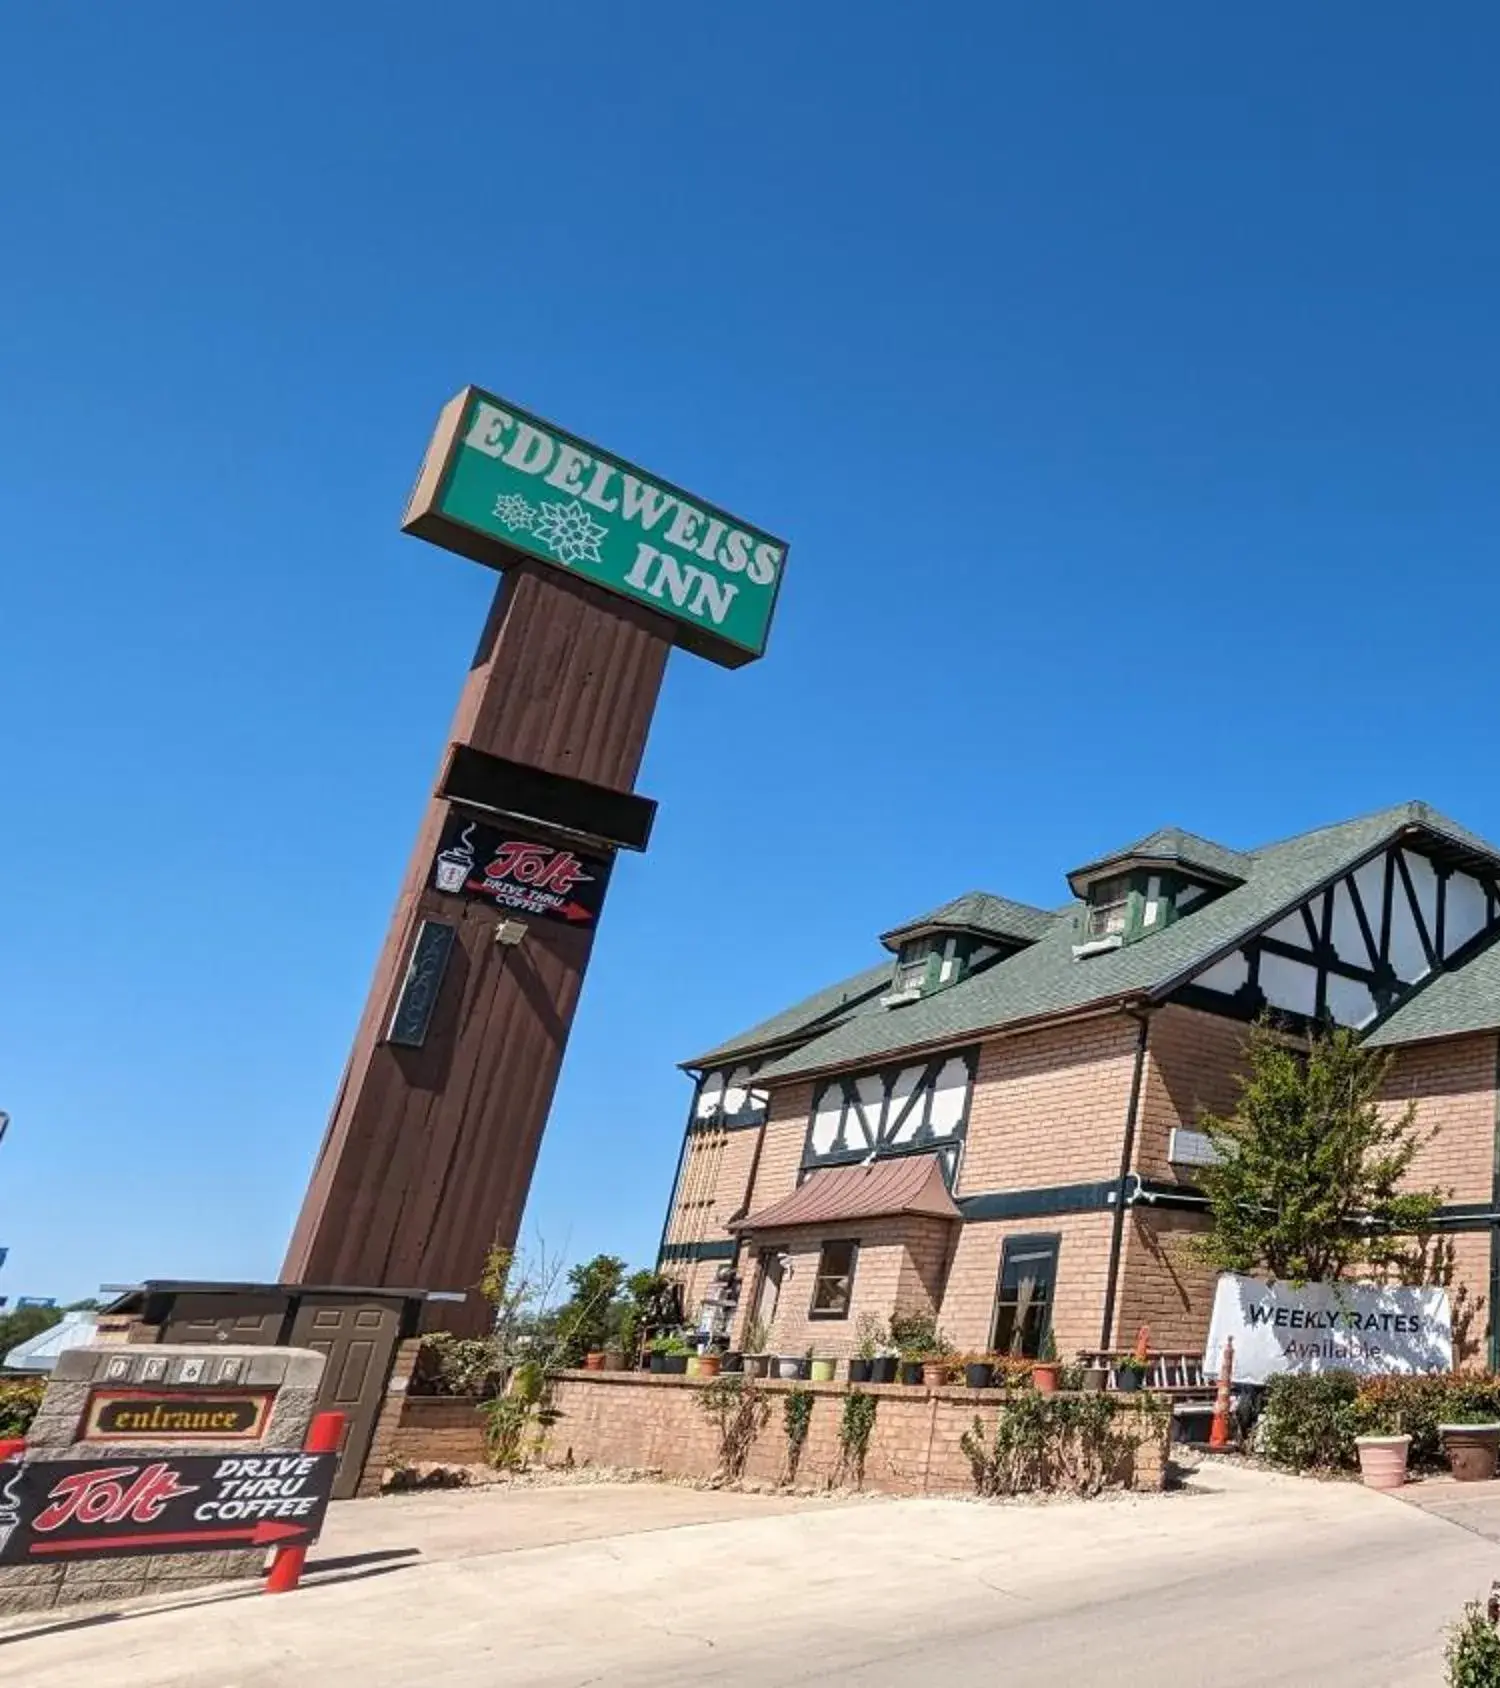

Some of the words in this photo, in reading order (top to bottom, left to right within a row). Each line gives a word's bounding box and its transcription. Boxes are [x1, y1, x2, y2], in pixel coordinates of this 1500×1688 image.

[464, 403, 781, 584] EDELWEISS
[624, 543, 738, 624] INN
[484, 842, 595, 894] Jolt
[482, 878, 527, 896] DRIVE
[528, 890, 565, 907] THRU
[496, 894, 545, 912] COFFEE
[1250, 1304, 1340, 1329] WEEKLY
[1349, 1312, 1420, 1332] RATES
[1283, 1339, 1381, 1359] Available
[115, 1405, 239, 1429] entrance
[214, 1457, 317, 1480] DRIVE
[33, 1463, 200, 1532] Jolt
[219, 1478, 305, 1499] THRU
[194, 1498, 317, 1522] COFFEE
